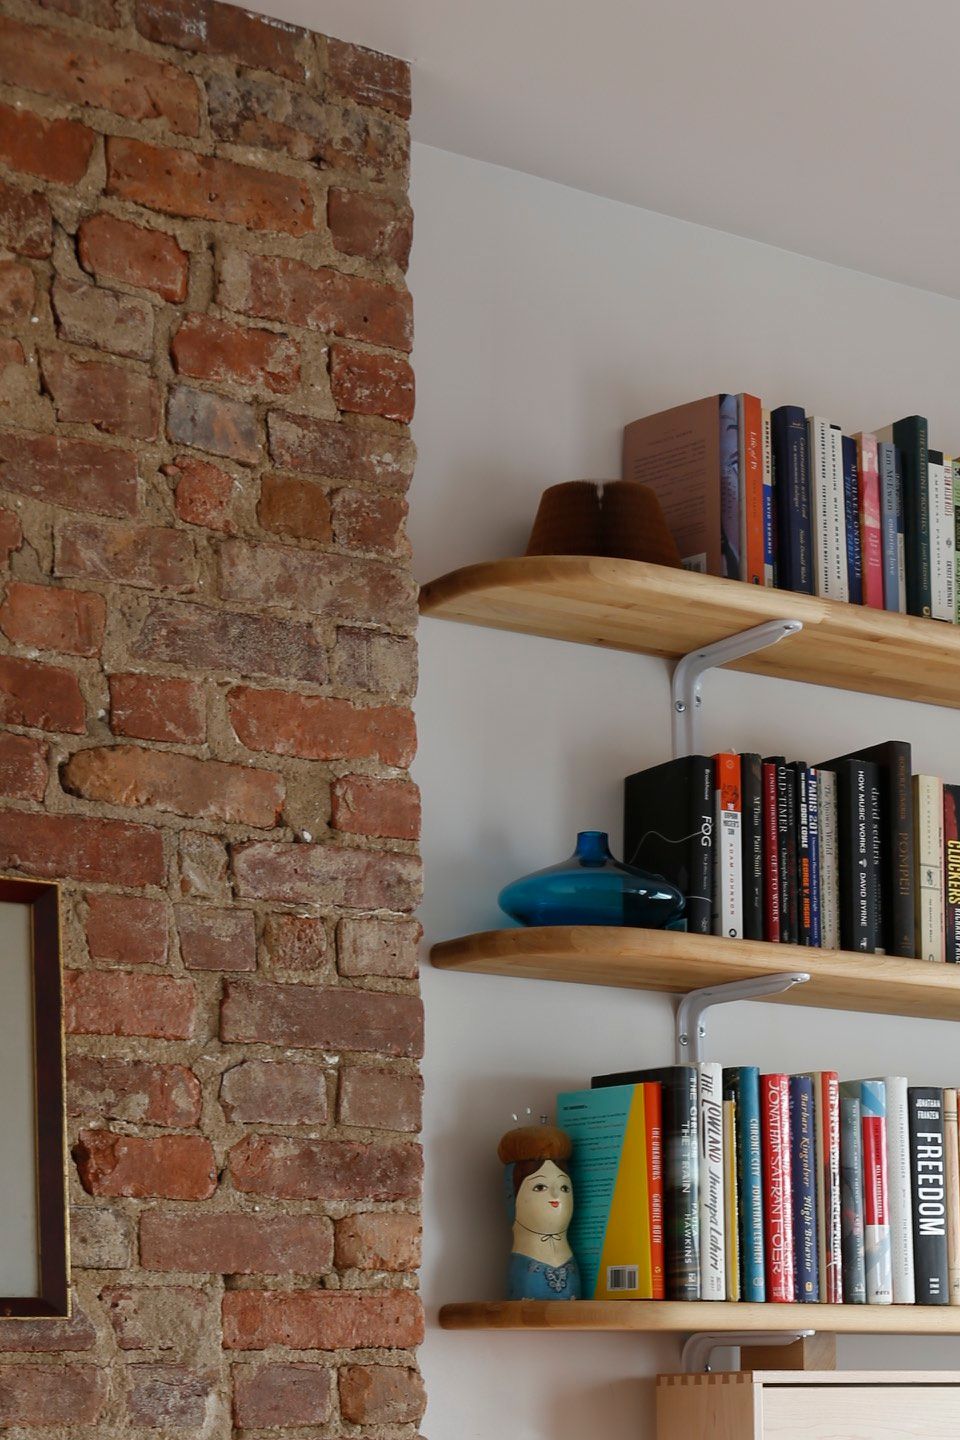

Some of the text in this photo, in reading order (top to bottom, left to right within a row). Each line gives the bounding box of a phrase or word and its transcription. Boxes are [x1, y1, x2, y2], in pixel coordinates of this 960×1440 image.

[750, 460, 757, 470] Pi
[851, 464, 862, 579] MICHAEL ONDAATJE
[886, 518, 896, 555] enduring
[921, 492, 929, 536] PROPHECY
[754, 796, 760, 804] M
[778, 766, 788, 832] OLD-TIMER
[800, 804, 808, 824] EDDIE
[809, 780, 818, 812] PARIS
[858, 793, 866, 820] MUSIC
[701, 816, 712, 847] FOG
[871, 787, 880, 865] david sedaris
[754, 854, 762, 878] Smith
[772, 876, 778, 890] TO
[899, 832, 910, 896] POMPEII
[803, 888, 810, 896] V.
[860, 900, 868, 927] BYRNE
[689, 1076, 698, 1158] THE GIRL ON
[700, 1072, 722, 1163] THE LOWLAND
[916, 1098, 941, 1108] JONATHAN
[917, 1110, 940, 1120] FRANZEN
[652, 1127, 661, 1181] THE UNKNOWNS
[681, 1121, 691, 1194] THE TRAIN
[750, 1118, 760, 1176] CHRONIC CITY
[800, 1093, 810, 1187] Barbara Kingsolver
[768, 1080, 782, 1274] JONATHAN SAFRAN FOER
[916, 1132, 945, 1236] FREEDOM
[652, 1193, 662, 1244] GABRIEL ROTH
[704, 1167, 722, 1272] Jhumpa Lahiri
[752, 1184, 762, 1264] JONATHAN LETHEM
[801, 1196, 812, 1225] Flight
[684, 1214, 692, 1264] HAWKINS
